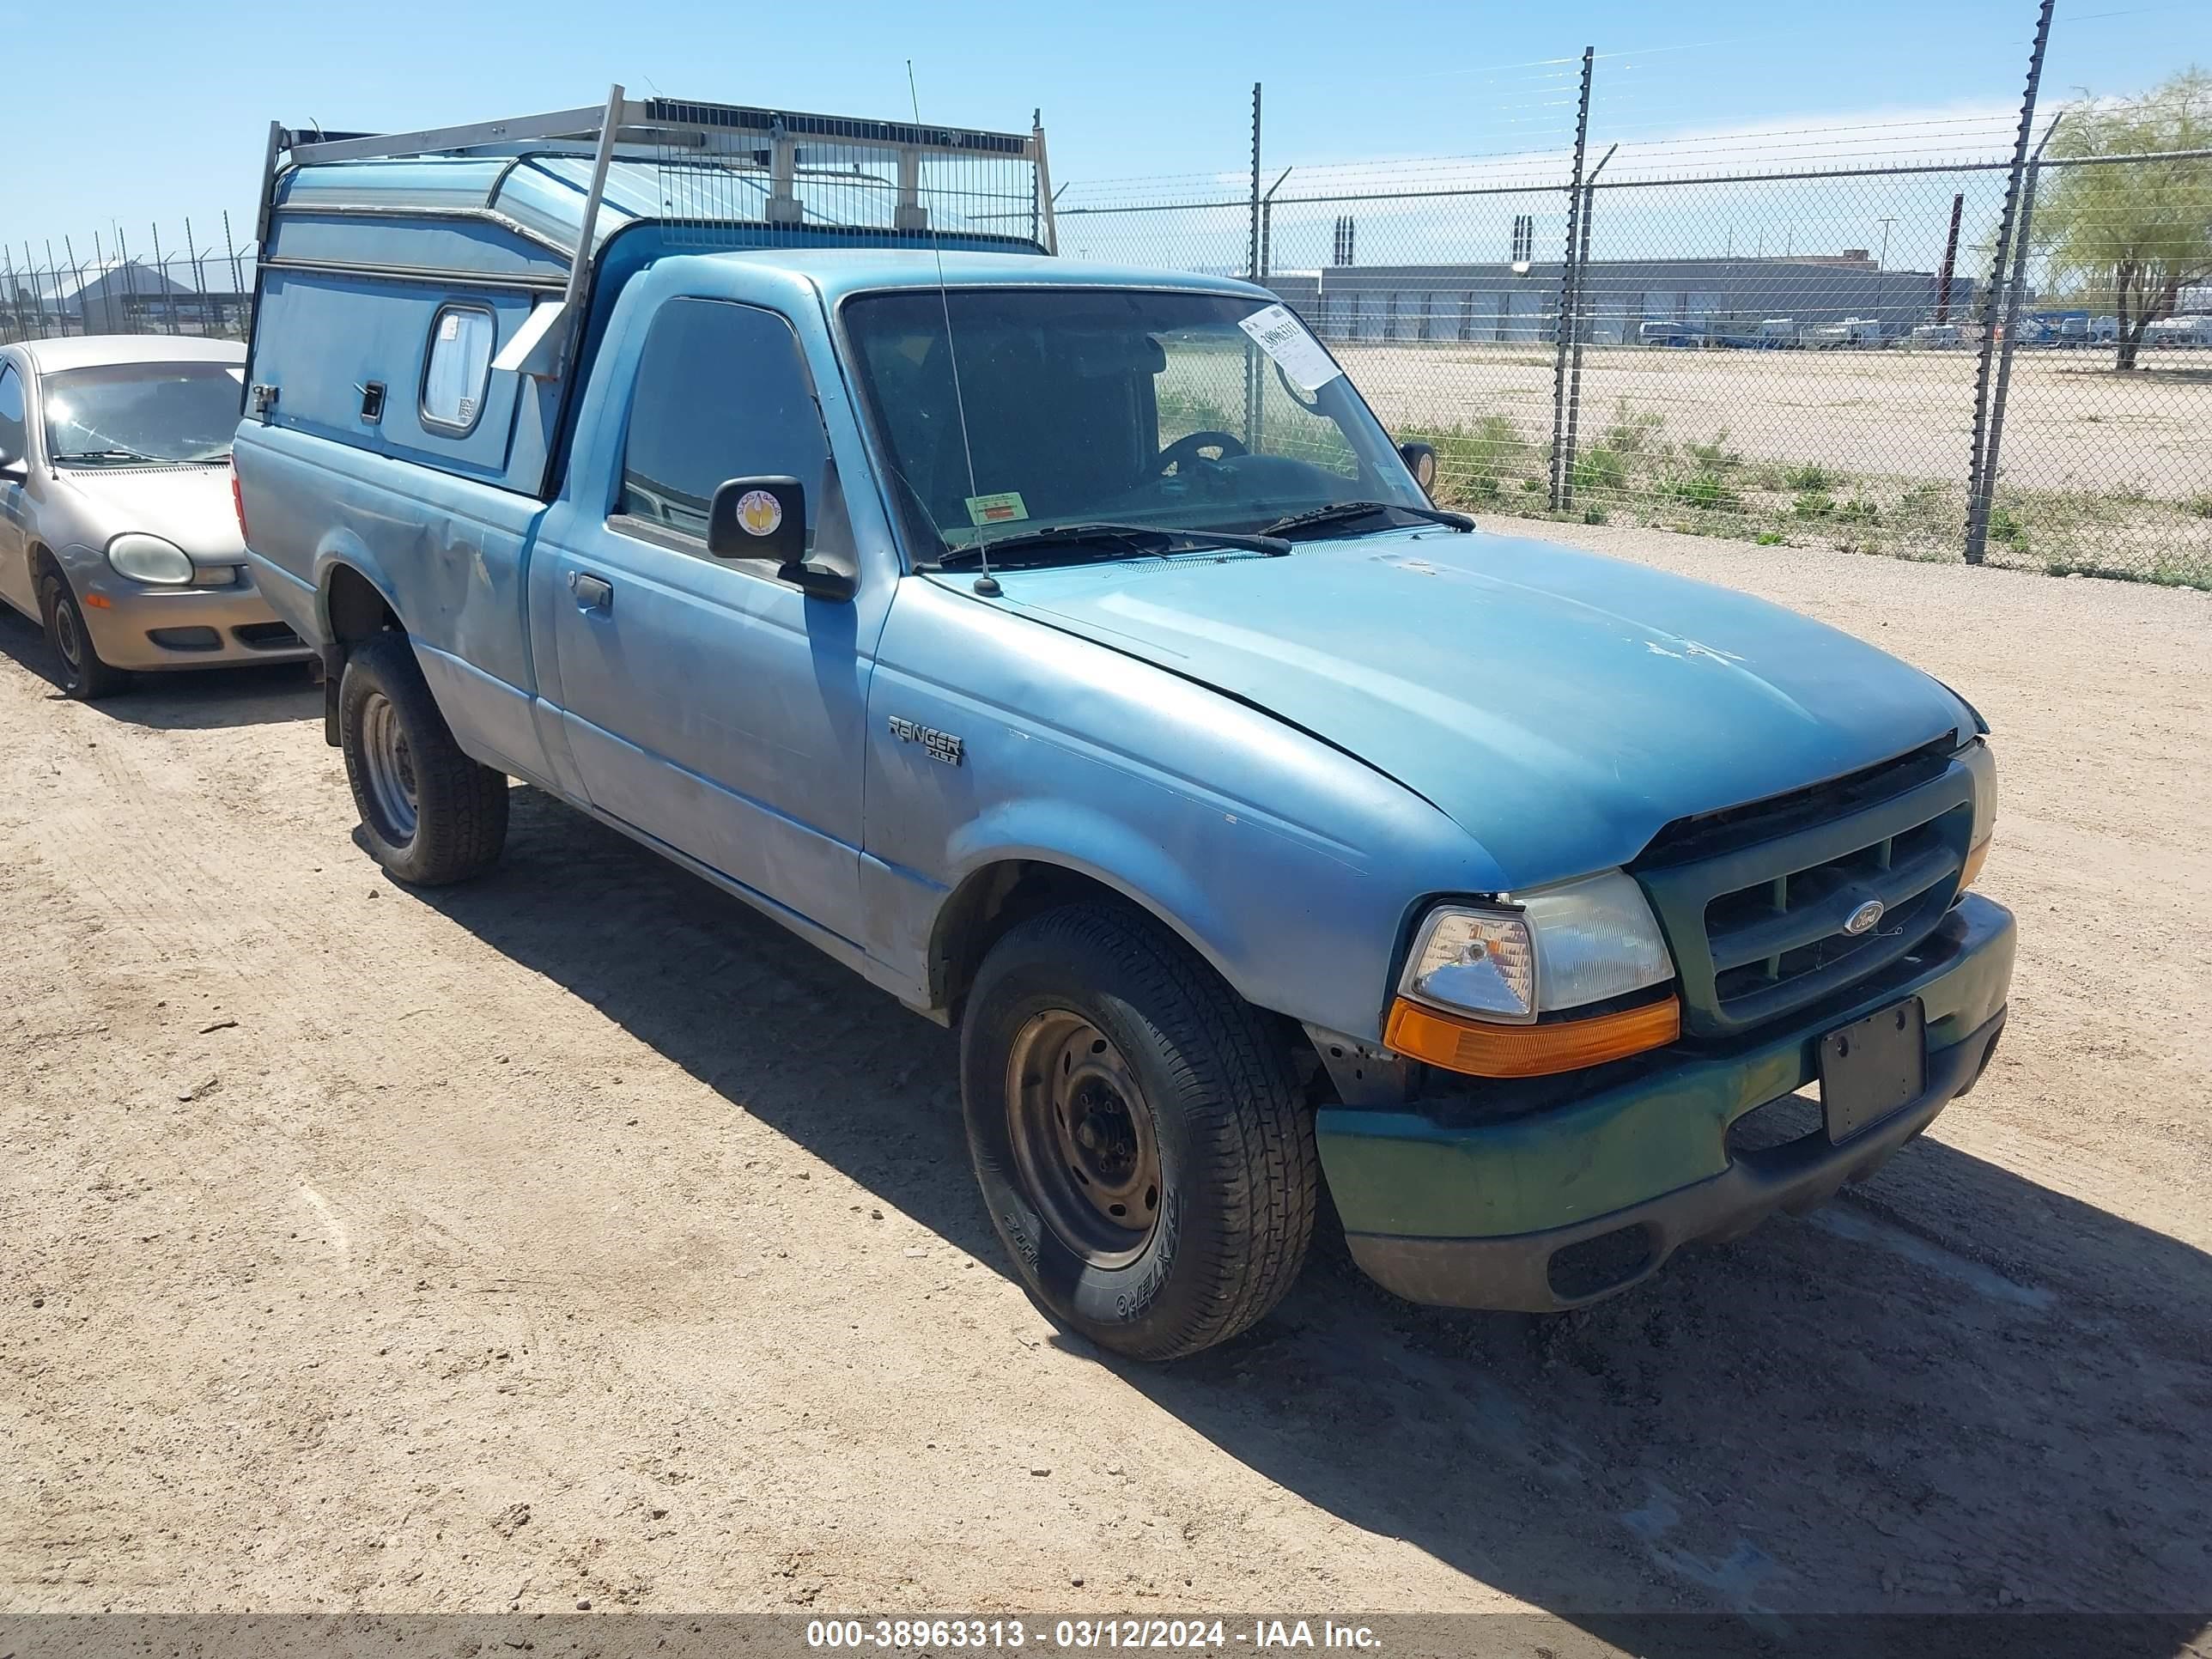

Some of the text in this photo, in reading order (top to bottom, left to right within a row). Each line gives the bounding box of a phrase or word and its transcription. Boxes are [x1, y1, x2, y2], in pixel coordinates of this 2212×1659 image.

[1260, 320, 1301, 349] 38963313
[888, 714, 963, 756] RANGER
[927, 748, 958, 765] XLT
[1856, 908, 1877, 928] Ford
[1115, 1187, 1176, 1316] DEXTERO
